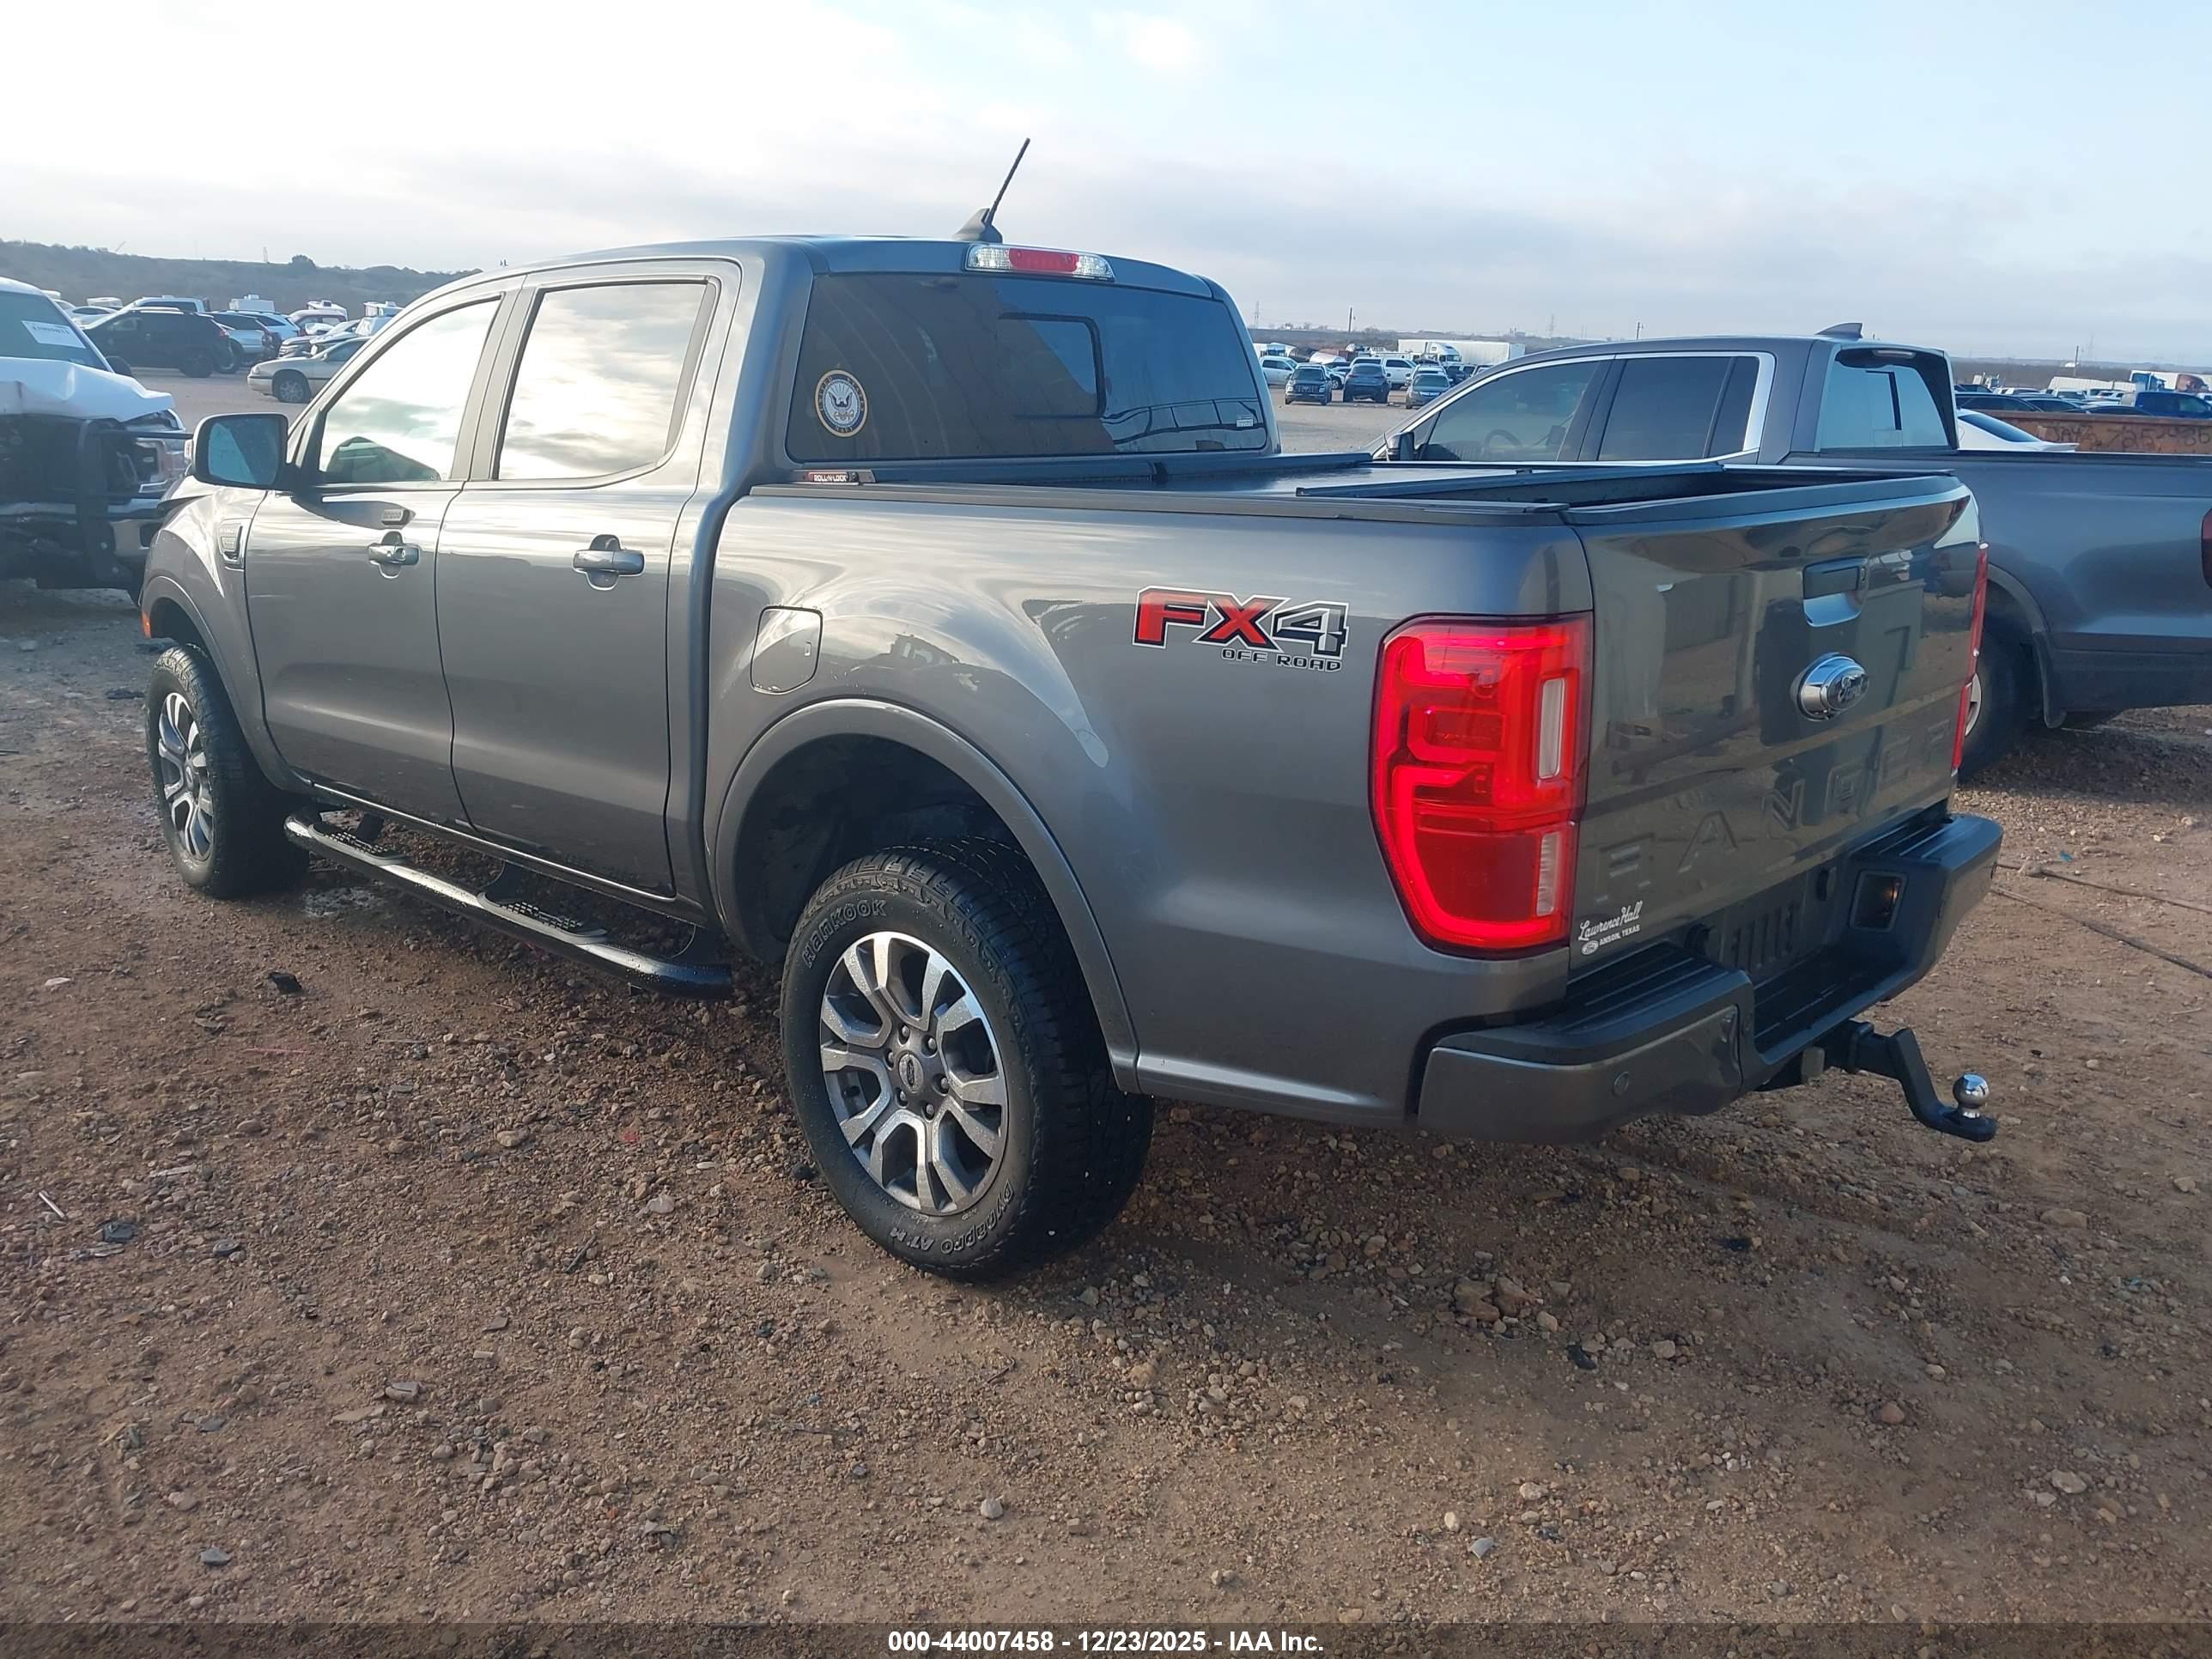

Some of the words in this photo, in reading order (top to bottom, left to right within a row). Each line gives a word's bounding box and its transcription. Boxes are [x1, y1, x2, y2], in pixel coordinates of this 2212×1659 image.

[1133, 585, 1349, 659] FX4
[1222, 648, 1267, 663] OFF
[1277, 655, 1341, 672] ROAD
